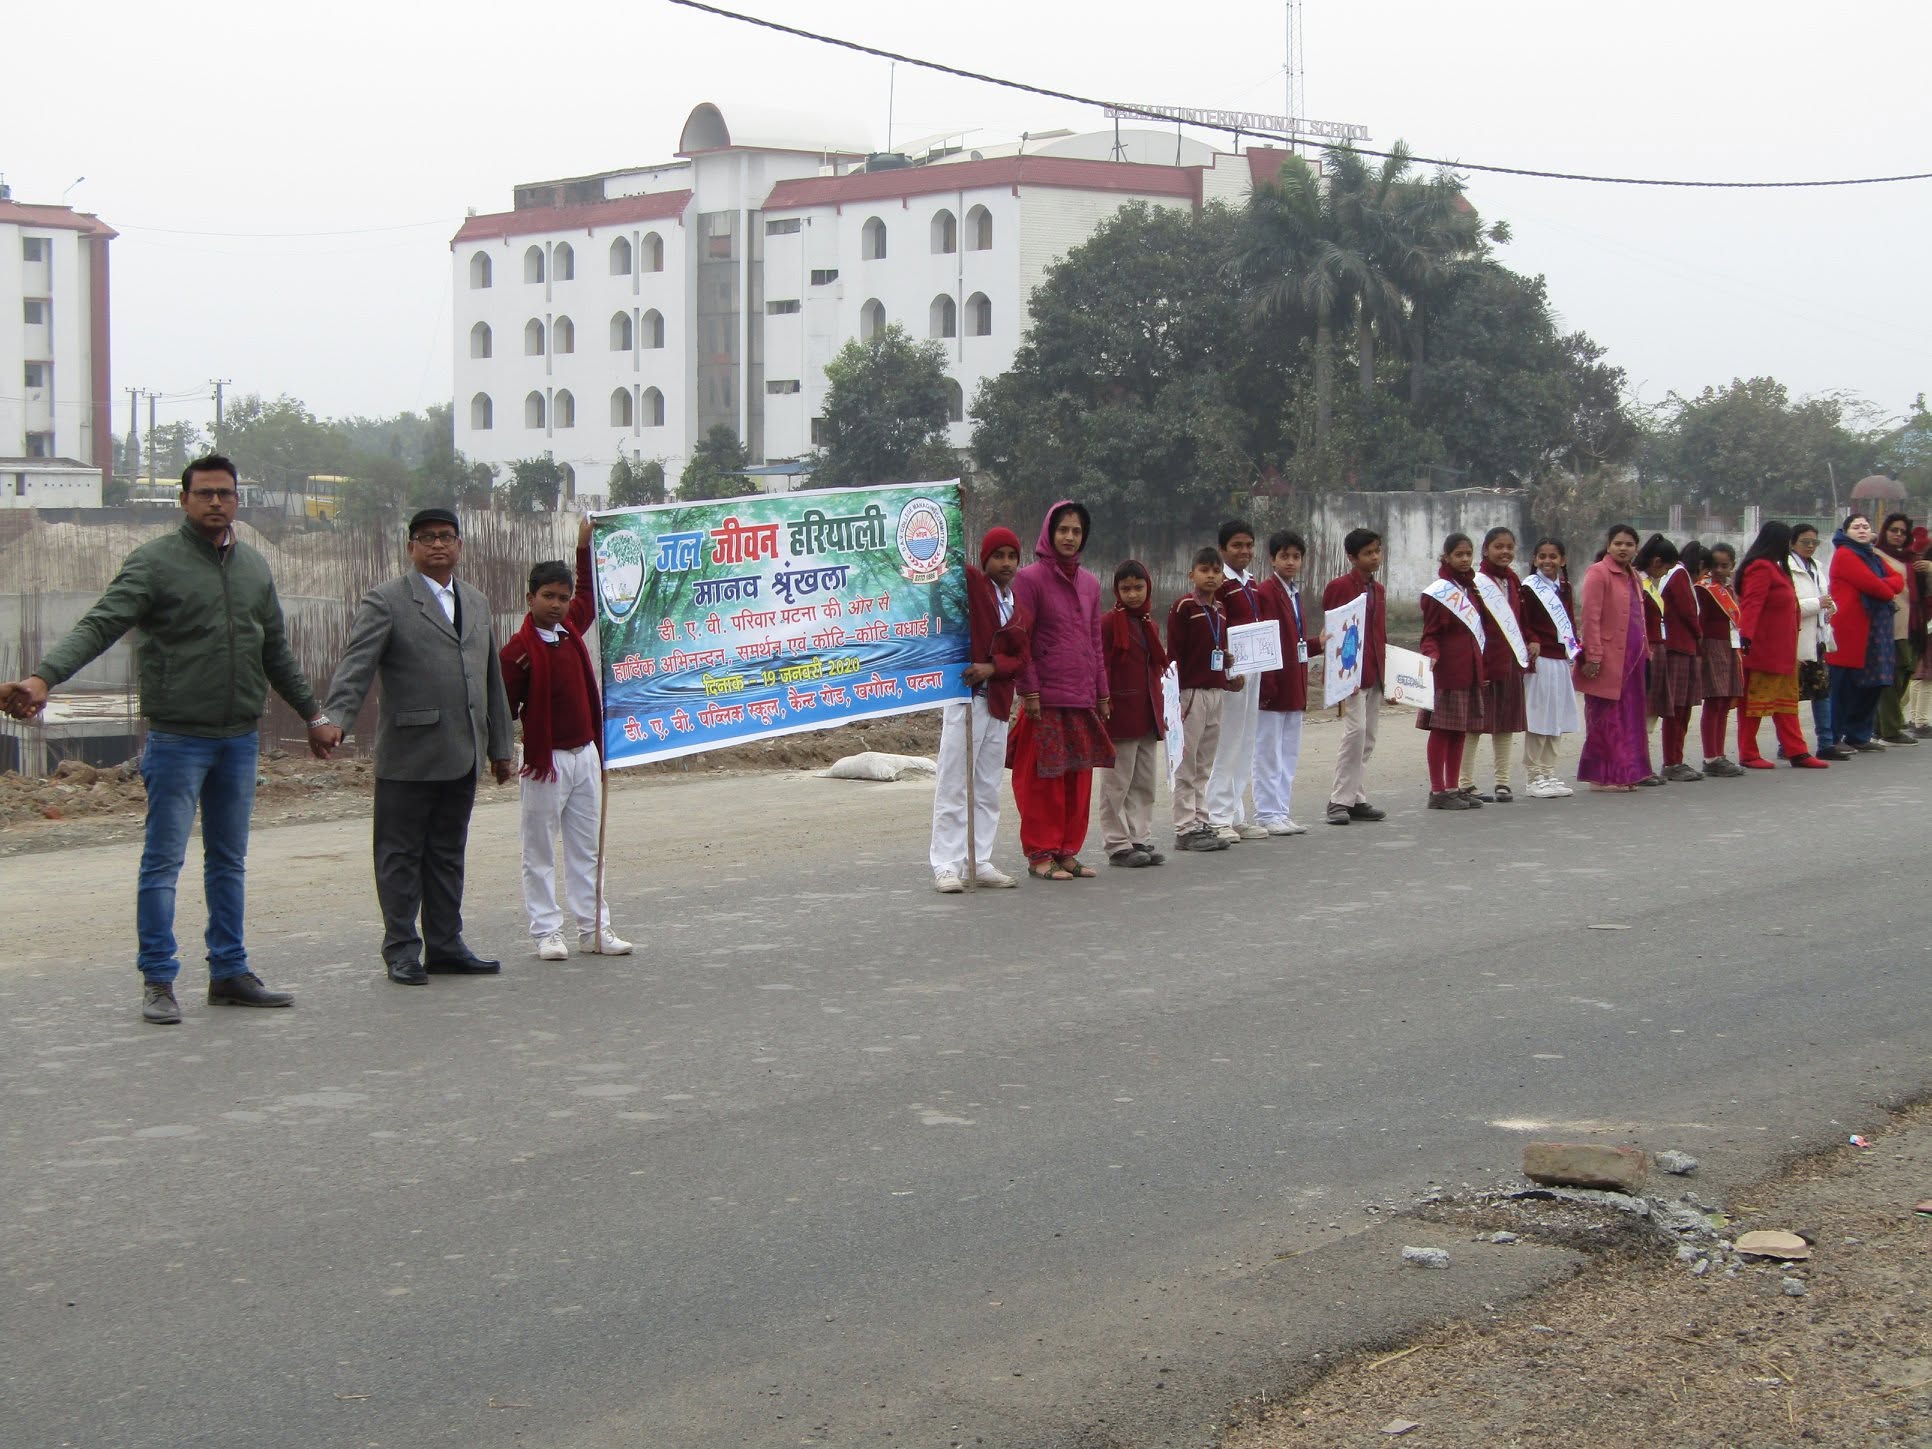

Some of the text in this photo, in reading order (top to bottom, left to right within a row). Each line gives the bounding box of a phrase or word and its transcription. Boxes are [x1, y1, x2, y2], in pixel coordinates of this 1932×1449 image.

[1182, 106, 1304, 132] INTERNATIONAL
[1309, 119, 1373, 141] SCHOOL
[656, 504, 888, 572] जल जीवन हरियाली
[692, 574, 762, 607] मानव
[1433, 583, 1476, 624] SAVE
[657, 592, 890, 642] डी. ए. वी. परिवार पटना की ओर से
[1548, 596, 1571, 633] WATER
[611, 651, 656, 682] हार्दिक
[660, 646, 733, 673] अभिनन्दन,
[736, 636, 782, 662] समर्थन
[787, 631, 807, 657] एवं
[894, 616, 929, 638] बधाई
[701, 670, 744, 697] दिनांक
[761, 669, 777, 688] 19
[780, 657, 823, 683] जनवरी
[828, 657, 861, 676] 2020
[624, 716, 648, 741] डी.
[649, 718, 669, 740] ए.
[671, 708, 694, 733] वी.
[747, 698, 786, 725] स्कूल,
[787, 684, 816, 711] कैन्ट
[820, 683, 851, 708] रोड,
[853, 671, 903, 700] खगौल,
[906, 669, 944, 692] पटना
